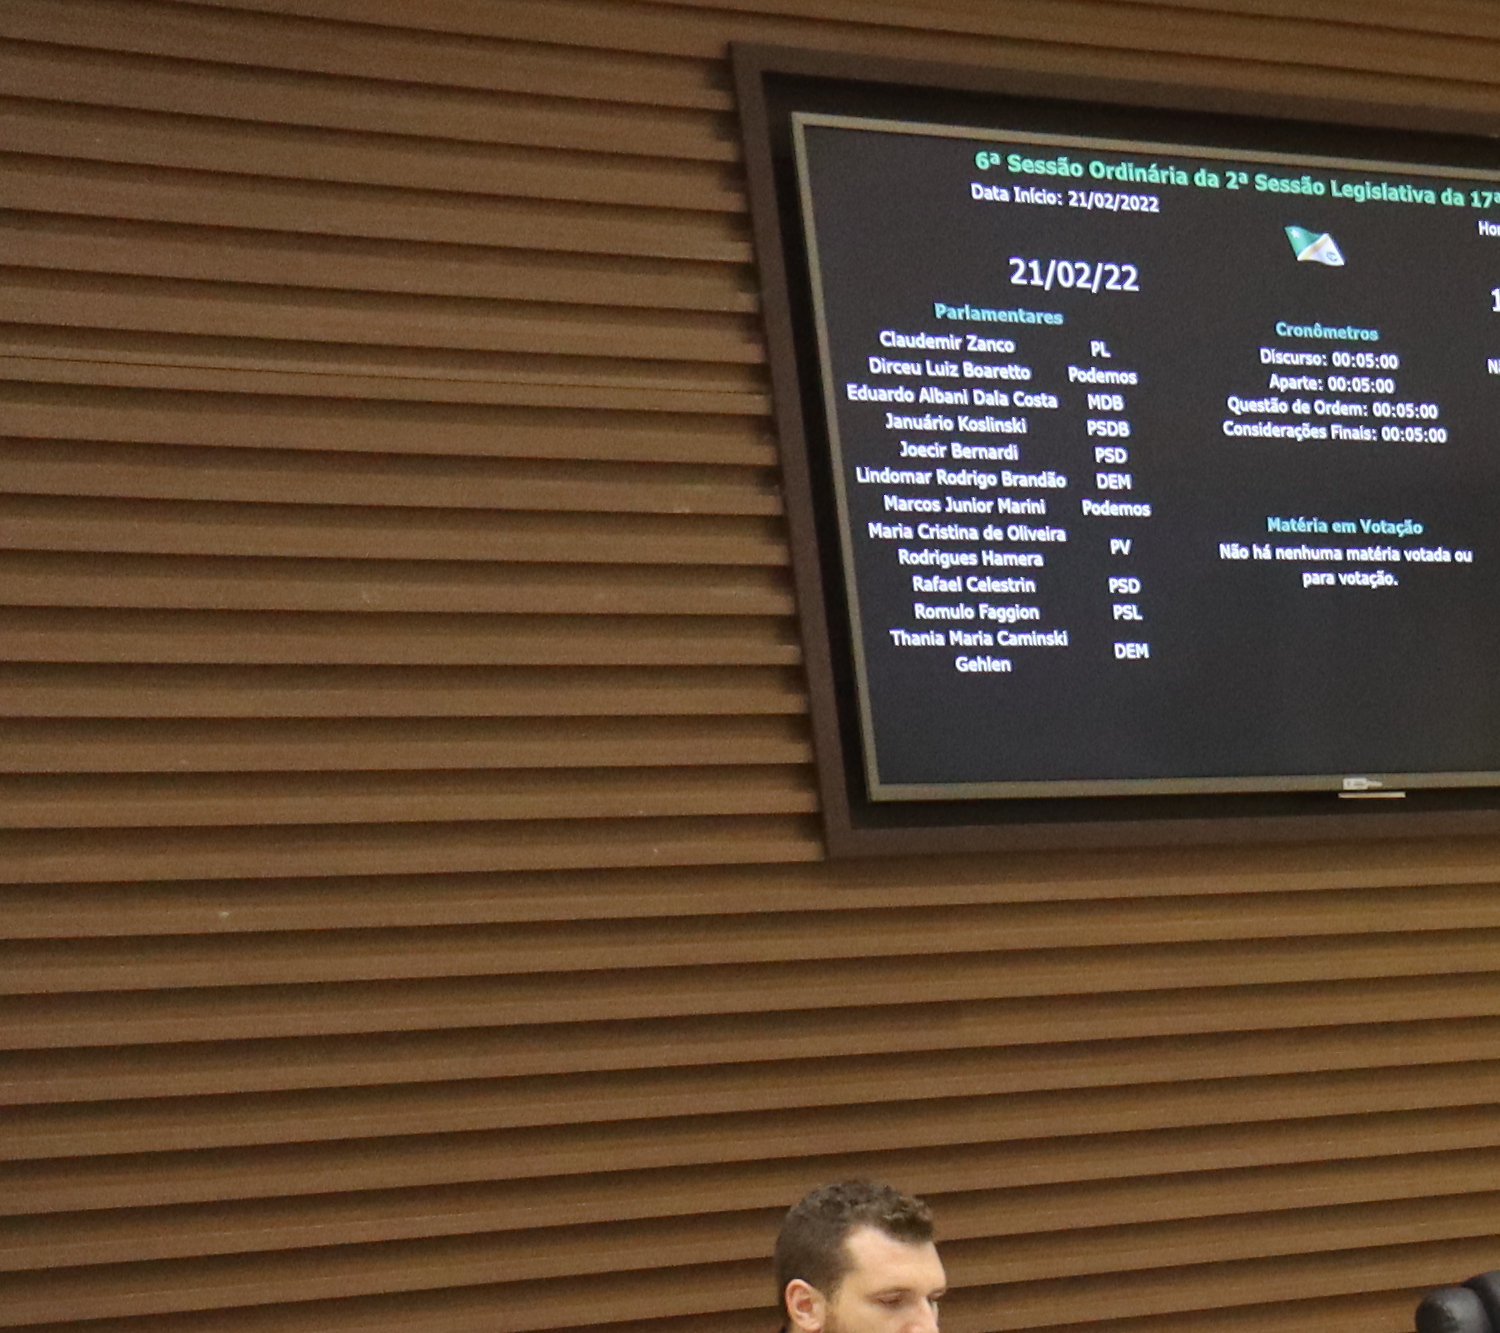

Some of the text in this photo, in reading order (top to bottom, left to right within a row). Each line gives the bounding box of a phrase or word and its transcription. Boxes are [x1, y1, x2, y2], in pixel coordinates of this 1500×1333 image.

[975, 151, 1001, 171] 6ª
[1007, 154, 1083, 177] Sessão
[1089, 160, 1189, 187] Ordinária
[1194, 168, 1220, 189] da
[1225, 171, 1249, 190] 2ª
[1255, 173, 1325, 195] Sessão
[1330, 179, 1436, 204] Legislativa
[1441, 188, 1465, 207] da
[971, 183, 1160, 213] Data Início: 21/02/2022
[1009, 258, 1140, 293] 21/02/22
[934, 302, 1064, 325] Parlamentares
[1275, 321, 1380, 341] Cronômetros
[879, 330, 1016, 354] Claudemir Zanco
[1090, 341, 1111, 358] PL
[869, 356, 1032, 381] Dirceu Luiz Boaretto
[1260, 347, 1400, 370] Discurso: 00:05:00
[1068, 366, 1138, 385] Podemos
[1269, 373, 1395, 394] Aparte: 00:05:00
[847, 383, 1059, 409] Eduardo Albani Dala Costa
[1088, 394, 1124, 411] MDB
[1227, 396, 1439, 419] Questão de Ordem: 00:05:00
[885, 412, 1027, 434] Januário Koslinski
[1087, 420, 1130, 437] PSDB
[1223, 420, 1448, 443] Considerações Finais: 00:05:00
[900, 441, 1019, 461] Joecir Bernardi
[1095, 447, 1128, 463] PSD
[856, 466, 1068, 490] Lindomar Rodrigo Brandão
[1096, 473, 1132, 490] DEM
[883, 494, 1046, 515] Marcos Junior Marini
[1082, 499, 1151, 517] Podemos
[868, 522, 1067, 543] Maria Cristina de Oliveira
[1267, 517, 1423, 537] Matéria em Votação
[1110, 538, 1132, 555] PV
[1219, 543, 1473, 562] Não há nenhuma matéria votada ou
[898, 548, 1044, 570] Rodrigues Hamera
[912, 576, 1036, 594] Rafael Celestrin
[1108, 577, 1141, 594] PSD
[1302, 570, 1399, 589] para votação.
[914, 603, 1040, 624] Romulo Faggion
[1113, 604, 1143, 620] PSL
[890, 629, 1069, 647] Thania Maria Caminski
[1114, 643, 1150, 660] DEM
[955, 655, 1012, 674] Gehlen
